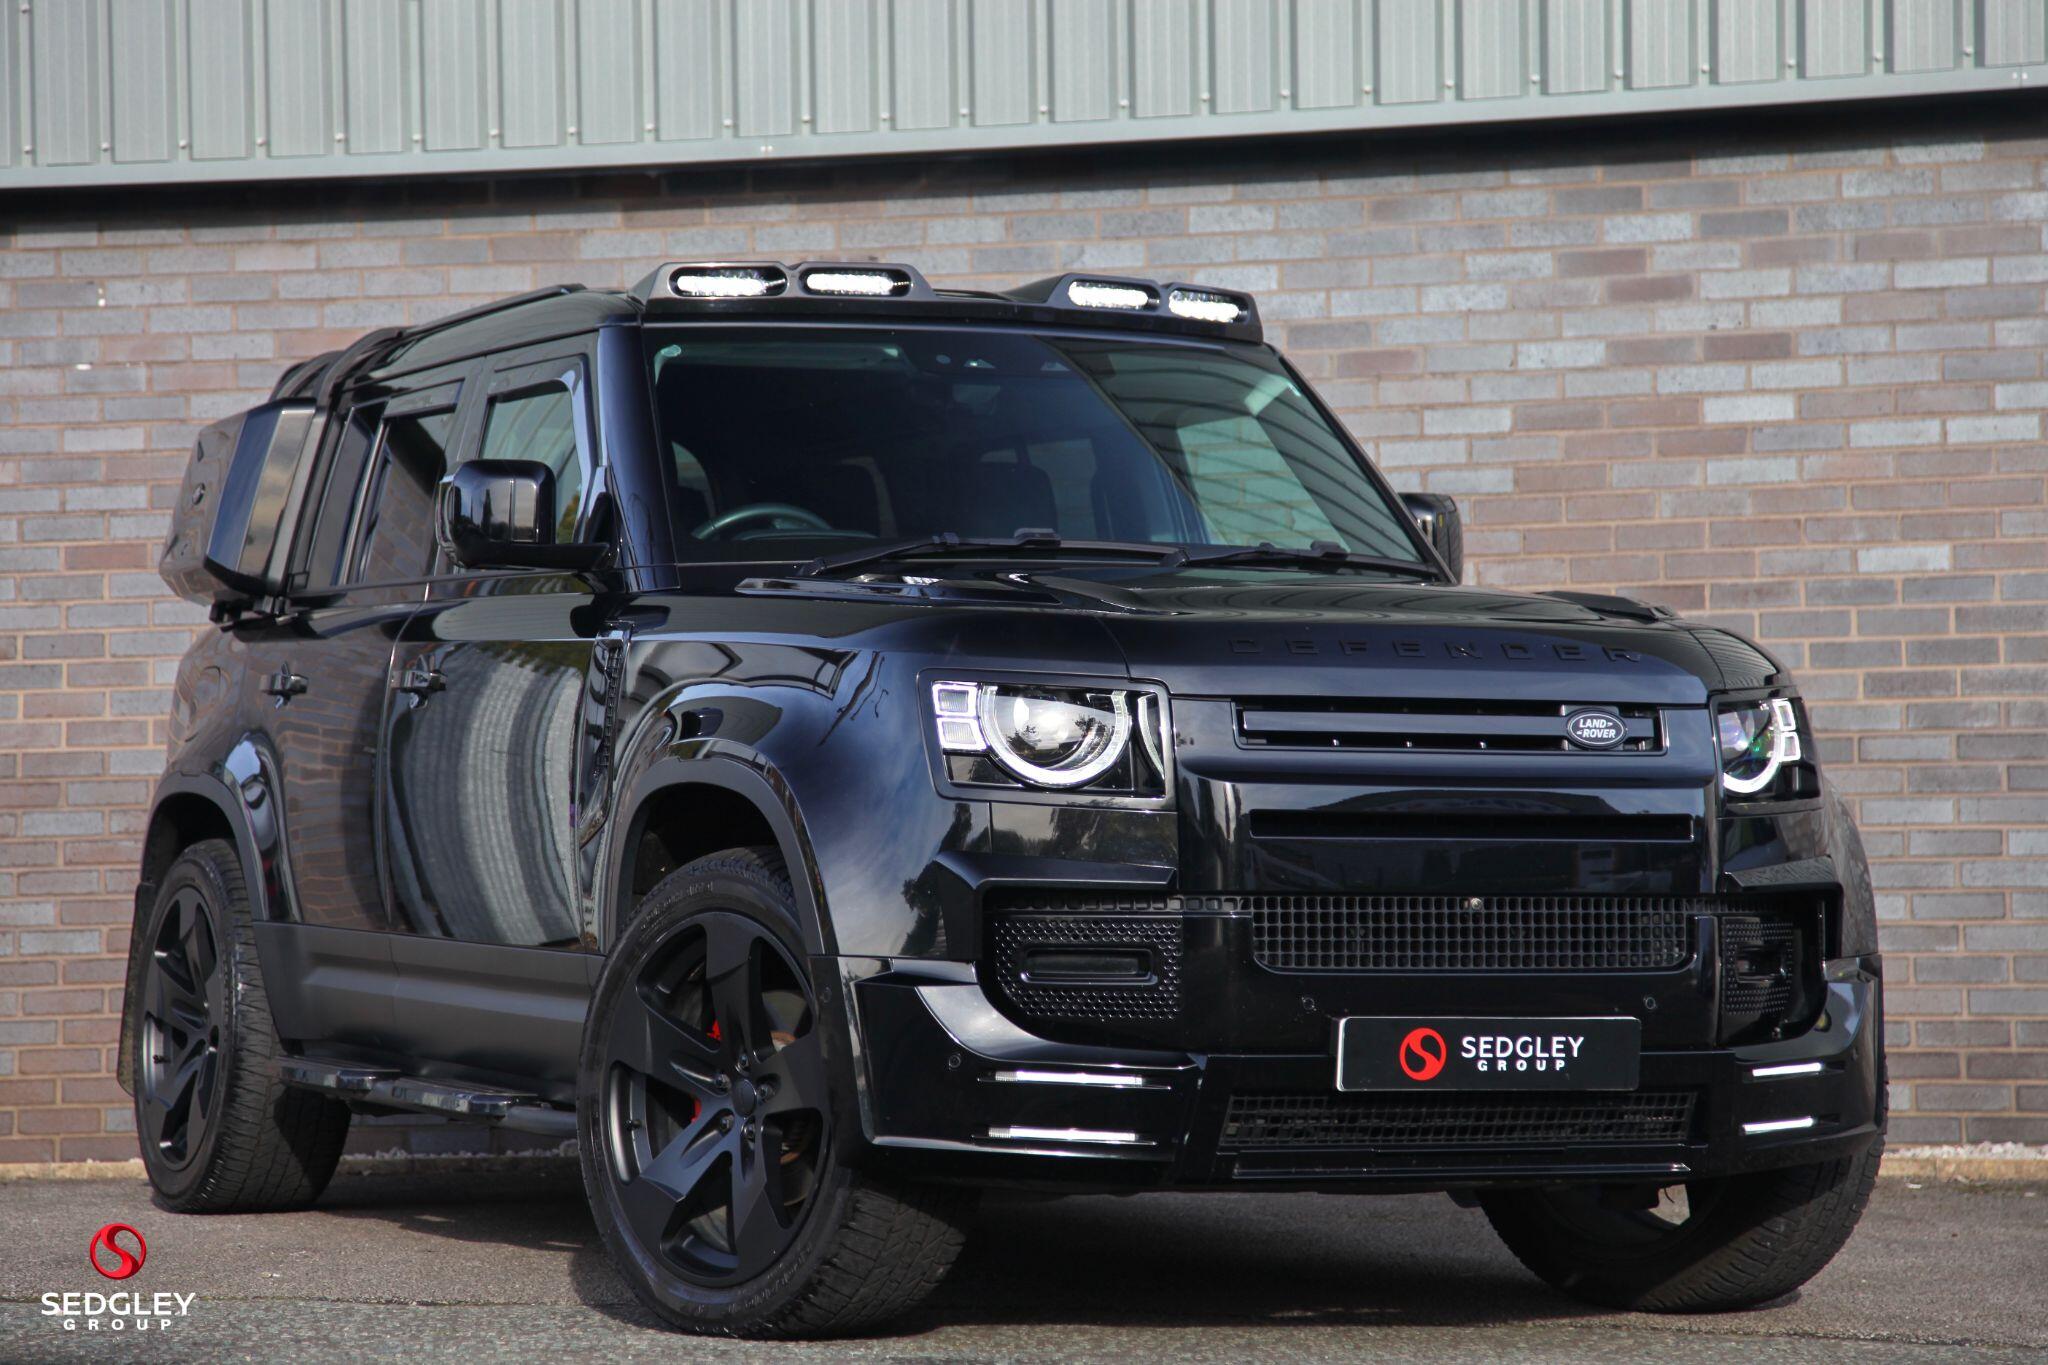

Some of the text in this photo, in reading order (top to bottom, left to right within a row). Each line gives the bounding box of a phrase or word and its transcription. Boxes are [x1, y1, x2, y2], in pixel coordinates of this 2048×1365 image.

[1228, 639, 1642, 662] DEFENDER
[1579, 718, 1607, 728] LAND
[1582, 729, 1616, 738] ROVER
[1461, 1036, 1584, 1058] SEDGLEY
[1477, 1060, 1565, 1071] GROUP
